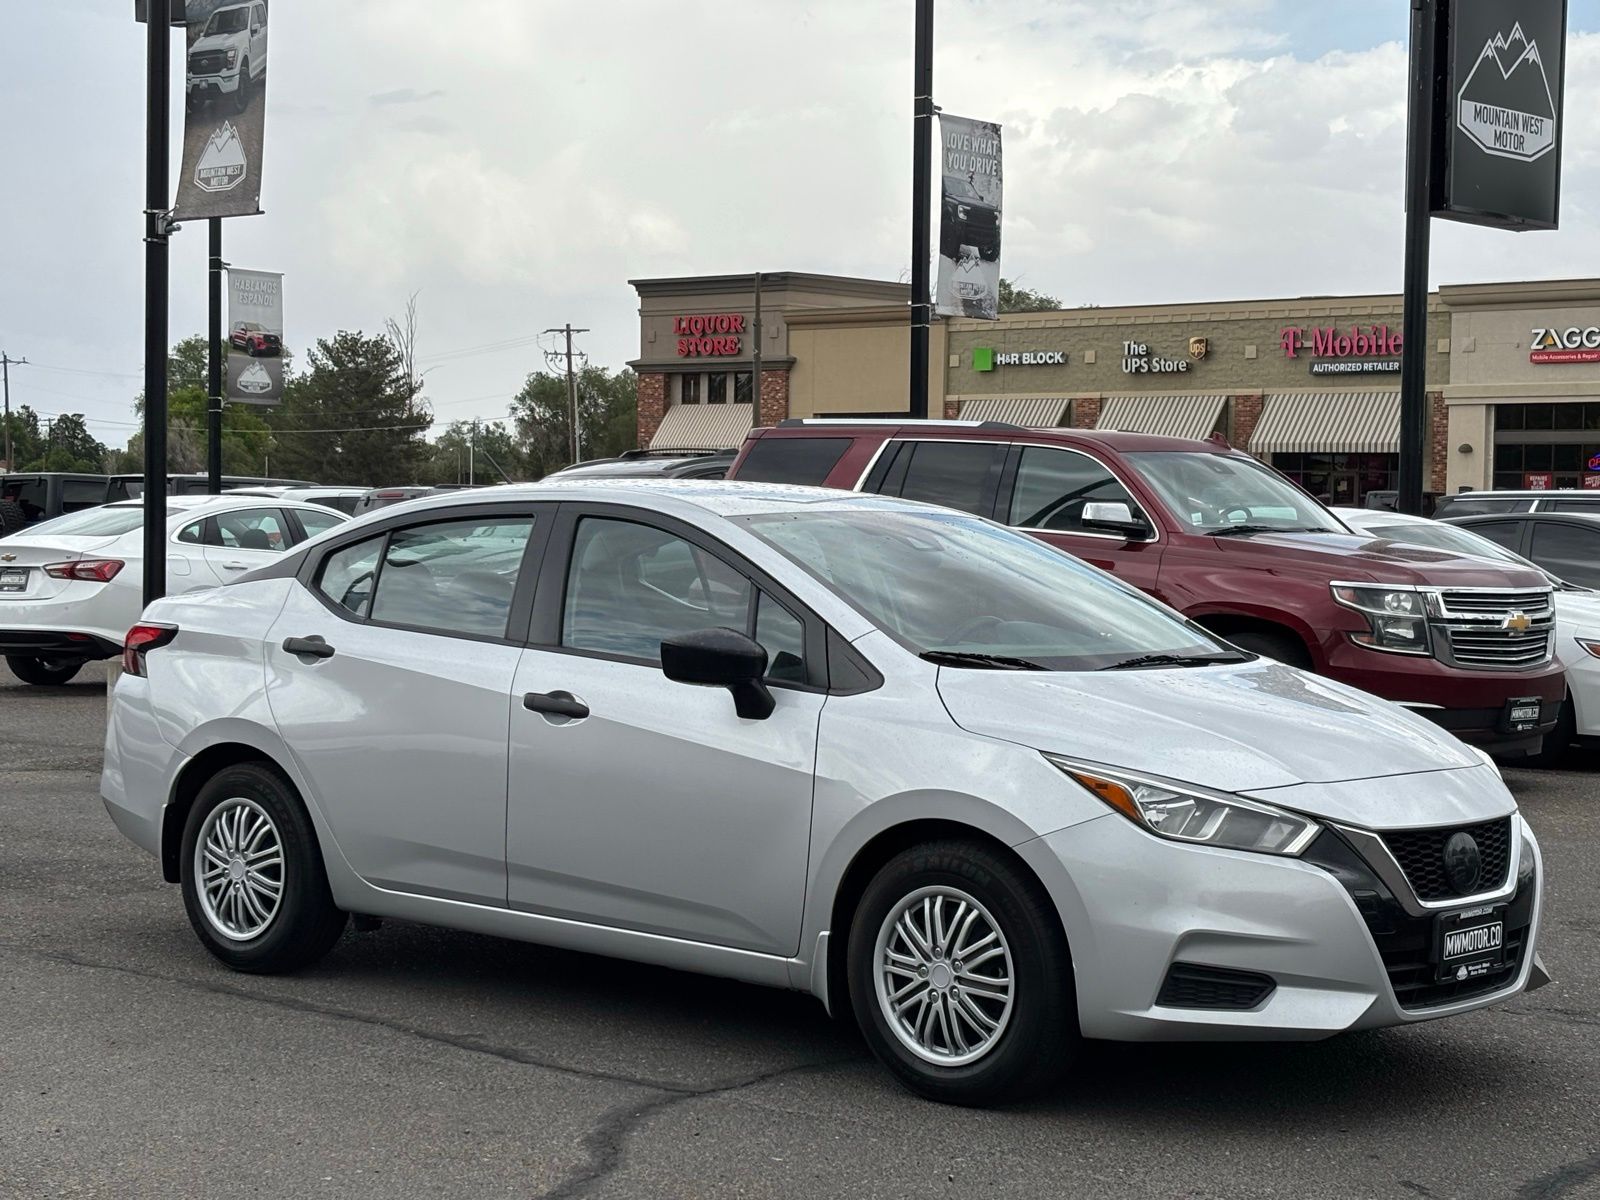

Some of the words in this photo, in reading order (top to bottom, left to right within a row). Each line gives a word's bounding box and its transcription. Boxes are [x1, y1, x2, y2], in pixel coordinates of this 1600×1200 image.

[1474, 104, 1519, 130] MOUNTAIN
[1521, 115, 1544, 136] WEST
[947, 132, 970, 151] LOVE
[971, 137, 998, 156] WHAT
[1494, 129, 1524, 151] MOTOR
[200, 167, 227, 178] MOUNTAIN
[226, 165, 241, 175] WEST
[948, 151, 966, 170] YOU
[970, 156, 997, 175] DRIVE
[210, 175, 229, 186] MOTOR
[234, 279, 277, 294] HABLAMOS
[672, 314, 744, 336] LIQUOR
[678, 336, 739, 356] STORE
[1531, 327, 1600, 349] ZAGG
[1122, 340, 1147, 356] The
[1190, 343, 1205, 356] ups
[996, 353, 1019, 365] H&R
[1021, 351, 1064, 365] BLOCK
[1121, 358, 1149, 373] UPS
[1151, 357, 1187, 373] Store
[1312, 362, 1362, 373] AUTHORIZED
[1363, 361, 1400, 372] RETAILER
[1446, 926, 1500, 956] MWMOTOR.CO
